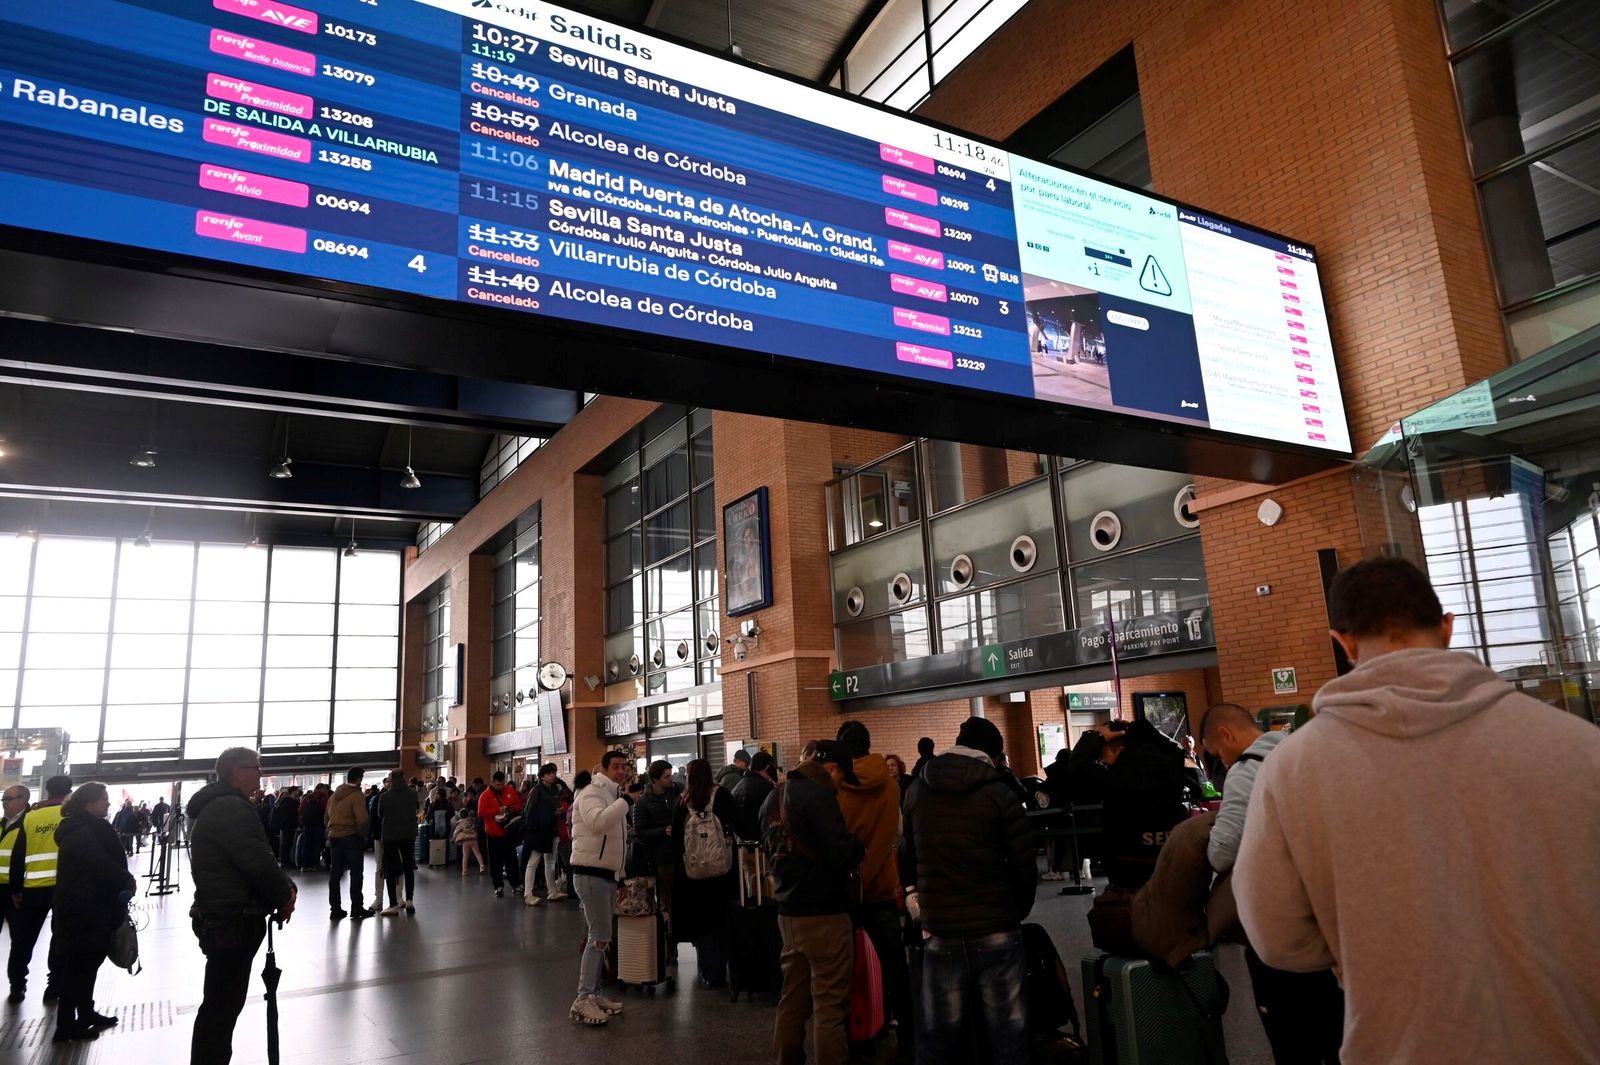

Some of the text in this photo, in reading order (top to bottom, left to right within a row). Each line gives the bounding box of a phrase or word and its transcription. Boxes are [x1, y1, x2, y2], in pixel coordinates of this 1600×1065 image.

[261, 9, 312, 28] AVE
[496, 3, 540, 21] adif
[216, 34, 256, 49] renfe
[324, 22, 377, 46] 10173
[550, 14, 653, 60] Salidas
[244, 50, 311, 74] Media Distancia
[471, 42, 516, 64] 11:19
[322, 64, 376, 87] 13079
[472, 23, 736, 116] 10:27 Sevilla Santa Justa
[212, 78, 253, 93] renfe
[470, 62, 638, 122] 10:49 Granada
[470, 82, 540, 109] Cancelado
[12, 78, 184, 134] Rabanales
[240, 93, 304, 116] Proximidad
[320, 106, 374, 129] 13208
[204, 99, 439, 164] DE SALIDA A VILLARRUBIA
[209, 122, 250, 138] renfe
[470, 120, 540, 148] Cancelado
[237, 138, 302, 159] Proximidad
[470, 101, 747, 187] 10:59 Alcolea de Córdoba
[882, 146, 903, 157] renfe
[932, 132, 986, 160] 11:18
[318, 150, 372, 172] 13255
[206, 168, 246, 184] renfe
[886, 178, 906, 189] renfe
[937, 164, 996, 192] 08694 4
[234, 184, 262, 197] Alvia
[470, 142, 878, 252] 11:06 Madrid Puerta de Atocha-A. Grand.
[1019, 168, 1076, 194] Alteraciones
[1076, 187, 1088, 196] en
[1099, 194, 1132, 212] servicio
[1020, 184, 1092, 210] por paro laboral
[315, 194, 371, 215] 00694
[940, 196, 970, 212] 08295
[202, 215, 244, 230] renfe
[469, 182, 743, 258] 11:15 Sevilla Santa Justa
[572, 185, 591, 199] de
[594, 188, 681, 222] Córdoba-Los
[684, 210, 749, 236] Pedroches
[757, 227, 822, 254] Puertollano
[830, 246, 868, 264] Ciudad
[888, 210, 909, 222] renfe
[1197, 216, 1232, 234] Llegadas
[232, 230, 264, 244] Avant
[943, 228, 973, 242] 13209
[313, 238, 369, 260] 08694
[468, 244, 540, 268] Cancelado
[548, 219, 838, 292] Córdoba Julio Anguita Córdoba Julio Anguita
[891, 244, 912, 256] renfe
[913, 253, 941, 266] AVE
[408, 254, 427, 273] 4
[468, 224, 777, 300] 11:33 Villarrubia de Córdoba
[946, 260, 1020, 284] 10091 BUS
[894, 276, 915, 288] renfe
[916, 286, 944, 298] AVE
[467, 286, 540, 310] Cancelado
[467, 265, 754, 332] 11:40 Alcolea de Córdoba
[950, 291, 1010, 315] 10070 3
[896, 310, 918, 321] renfe
[952, 324, 983, 339] 13212
[900, 344, 921, 355] renfe
[956, 358, 986, 371] 13229
[1081, 636, 1105, 648] Pago
[1124, 636, 1180, 651] PARKING PAY POINT
[1008, 646, 1034, 661] Salida
[1010, 662, 1020, 670] EXIT
[846, 675, 859, 694] P2
[610, 712, 631, 734] PAUSA
[1142, 832, 1170, 846] SE
